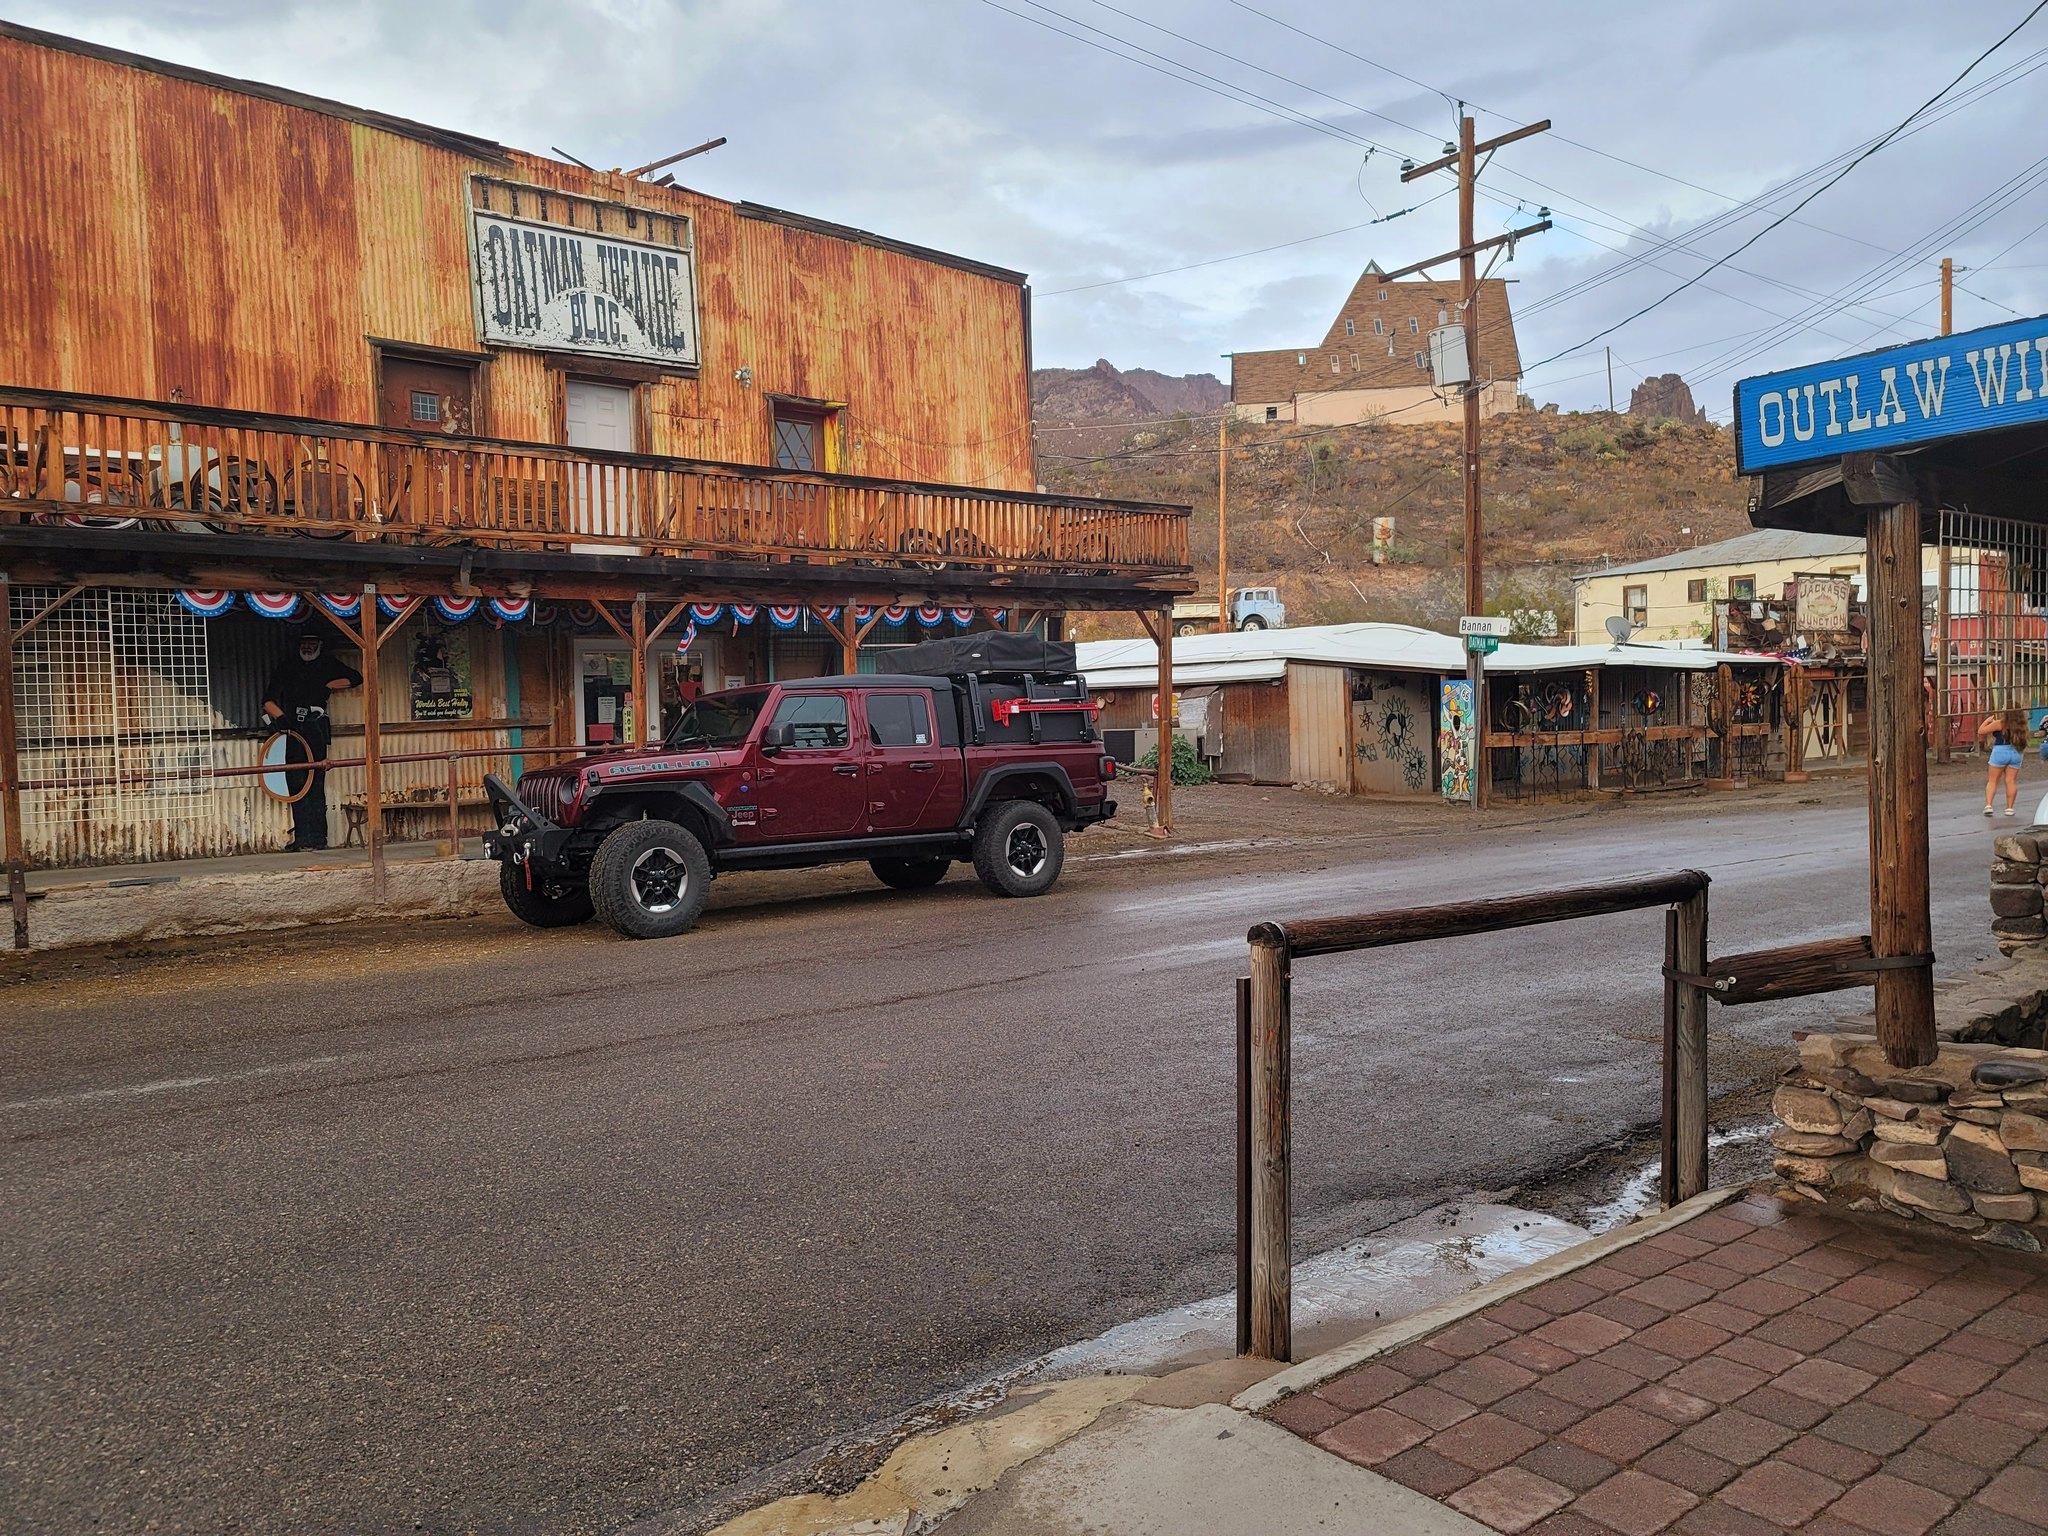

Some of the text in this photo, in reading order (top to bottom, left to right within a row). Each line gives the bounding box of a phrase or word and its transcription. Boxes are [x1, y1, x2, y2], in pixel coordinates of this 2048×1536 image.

[488, 224, 685, 353] OATMAN THEATRE
[570, 292, 628, 343] BLDG.
[1758, 356, 1951, 448] OUTLAW
[1800, 583, 1847, 600] JACKASS
[1461, 620, 1507, 633] Bannan Ln
[1799, 613, 1846, 626] JUNCTION
[732, 810, 755, 820] Jeep
